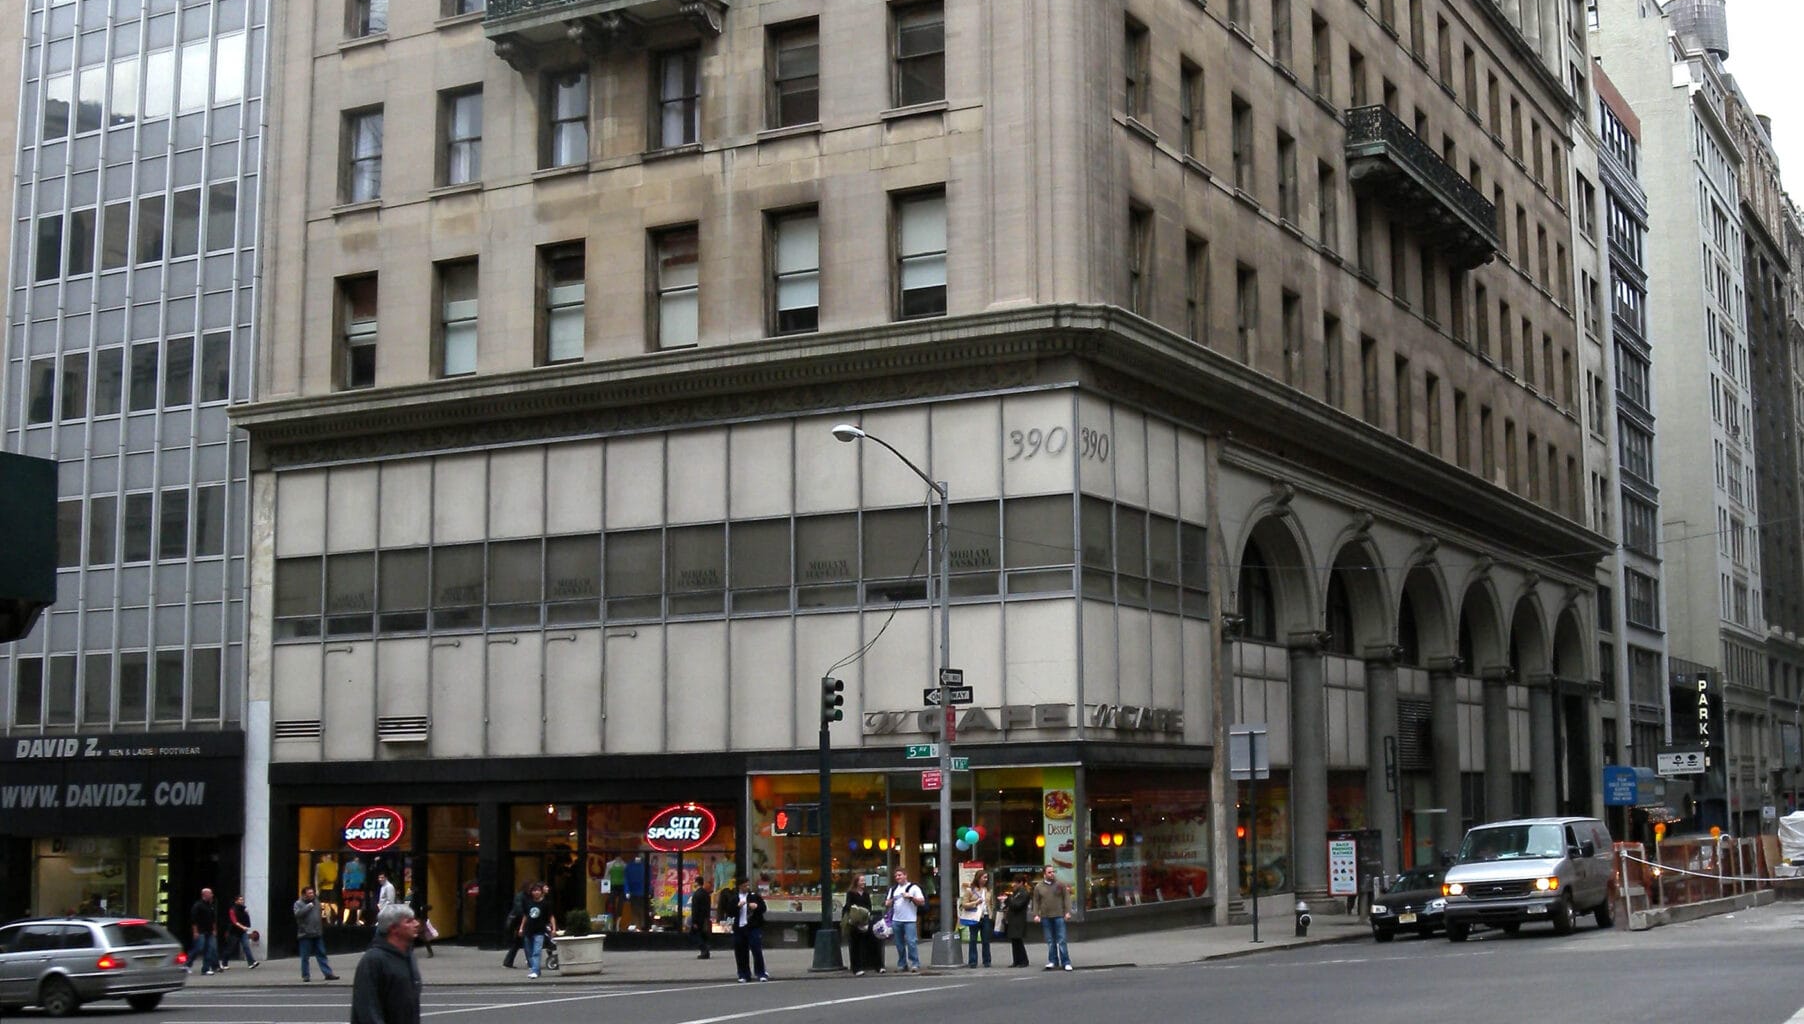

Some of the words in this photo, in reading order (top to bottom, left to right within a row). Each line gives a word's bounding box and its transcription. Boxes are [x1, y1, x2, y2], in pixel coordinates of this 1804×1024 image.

[1007, 426, 1068, 462] 390
[1081, 426, 1109, 463] 390
[15, 738, 79, 759] DAVID
[84, 737, 103, 757] Z.
[159, 746, 200, 756] FOOTWEAR
[909, 746, 917, 757] 5
[65, 783, 147, 808] DAVIDZ.
[154, 781, 206, 806] COM
[363, 817, 392, 829] CITY
[670, 816, 702, 829] CITY
[344, 828, 390, 840] SPORTS
[647, 827, 701, 840] SPORTS
[1047, 823, 1073, 836] Dessert
